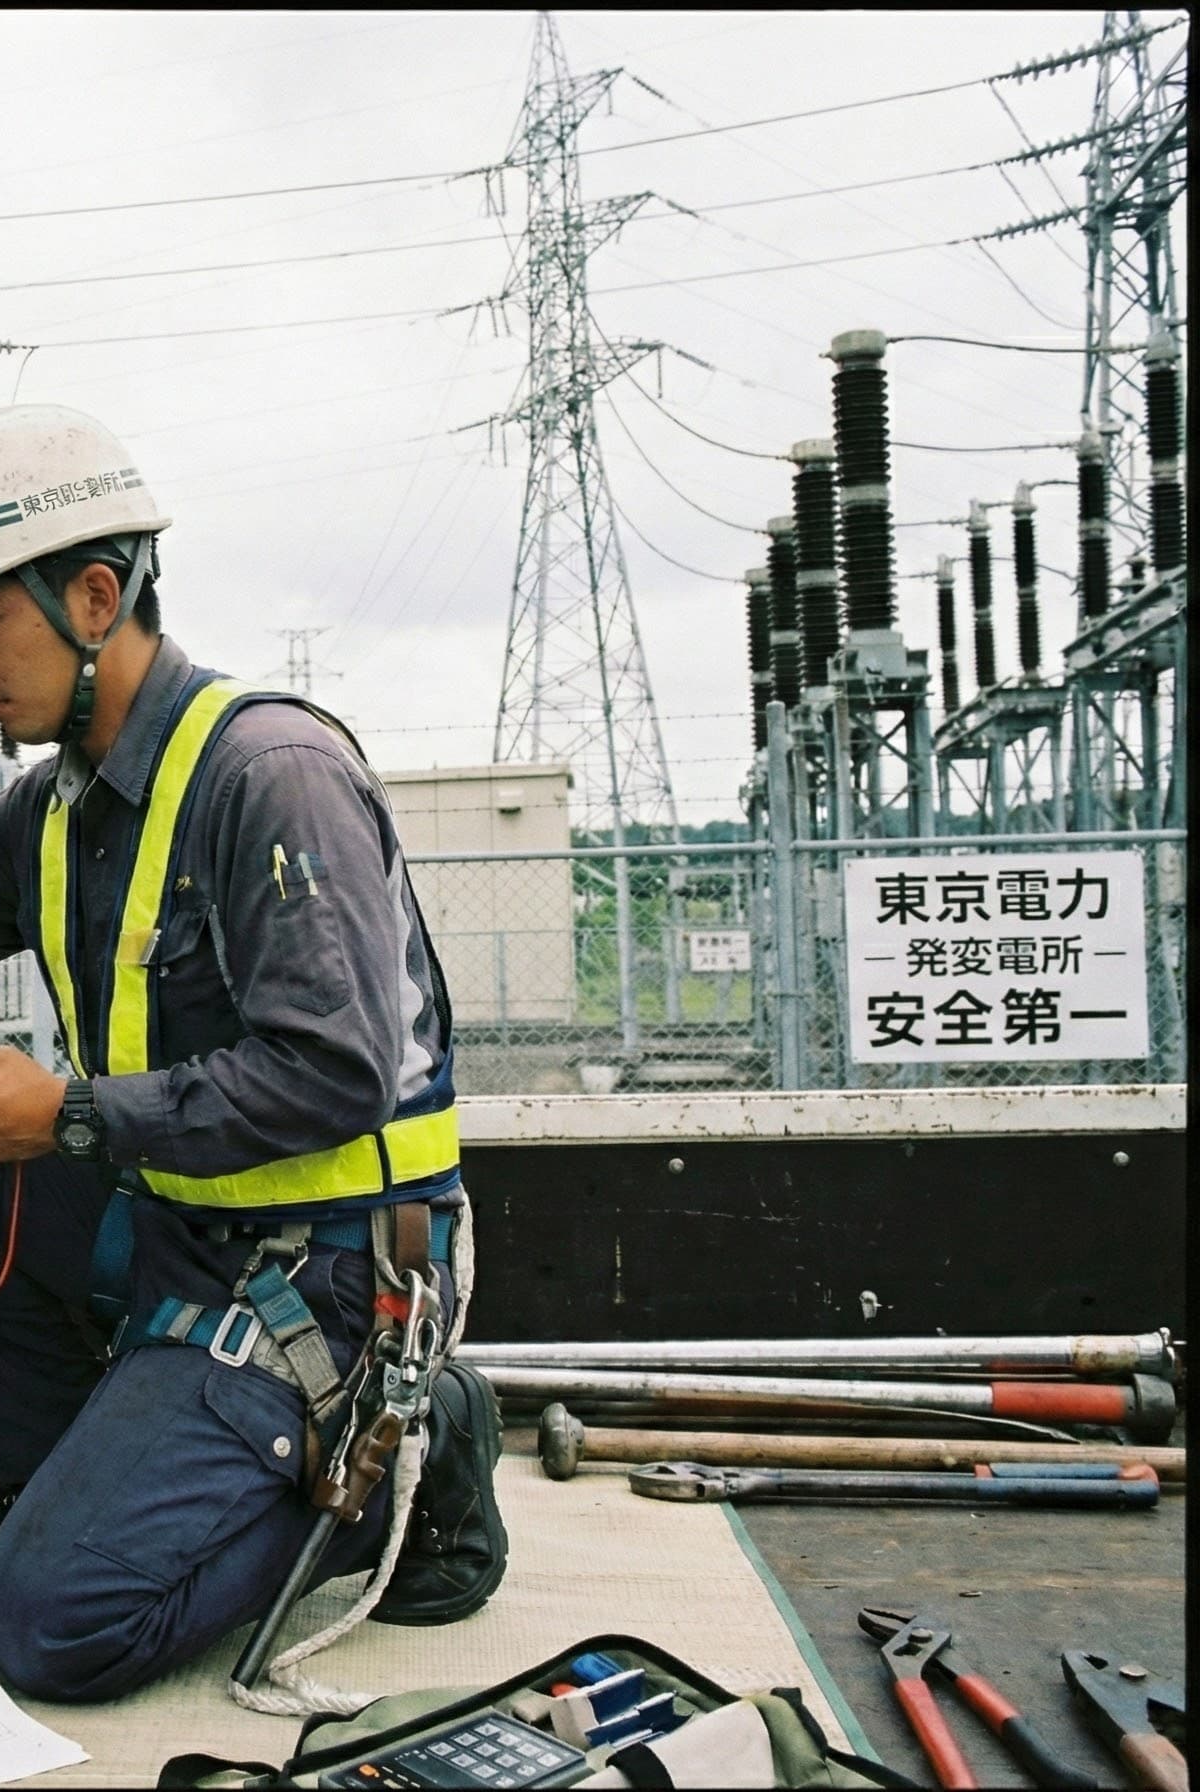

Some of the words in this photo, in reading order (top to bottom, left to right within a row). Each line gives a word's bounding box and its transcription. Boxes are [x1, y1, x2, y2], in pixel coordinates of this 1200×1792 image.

[874, 867, 1109, 926] 東京電力
[905, 935, 1084, 978] 発変電所
[866, 987, 1128, 1049] 安全第一
